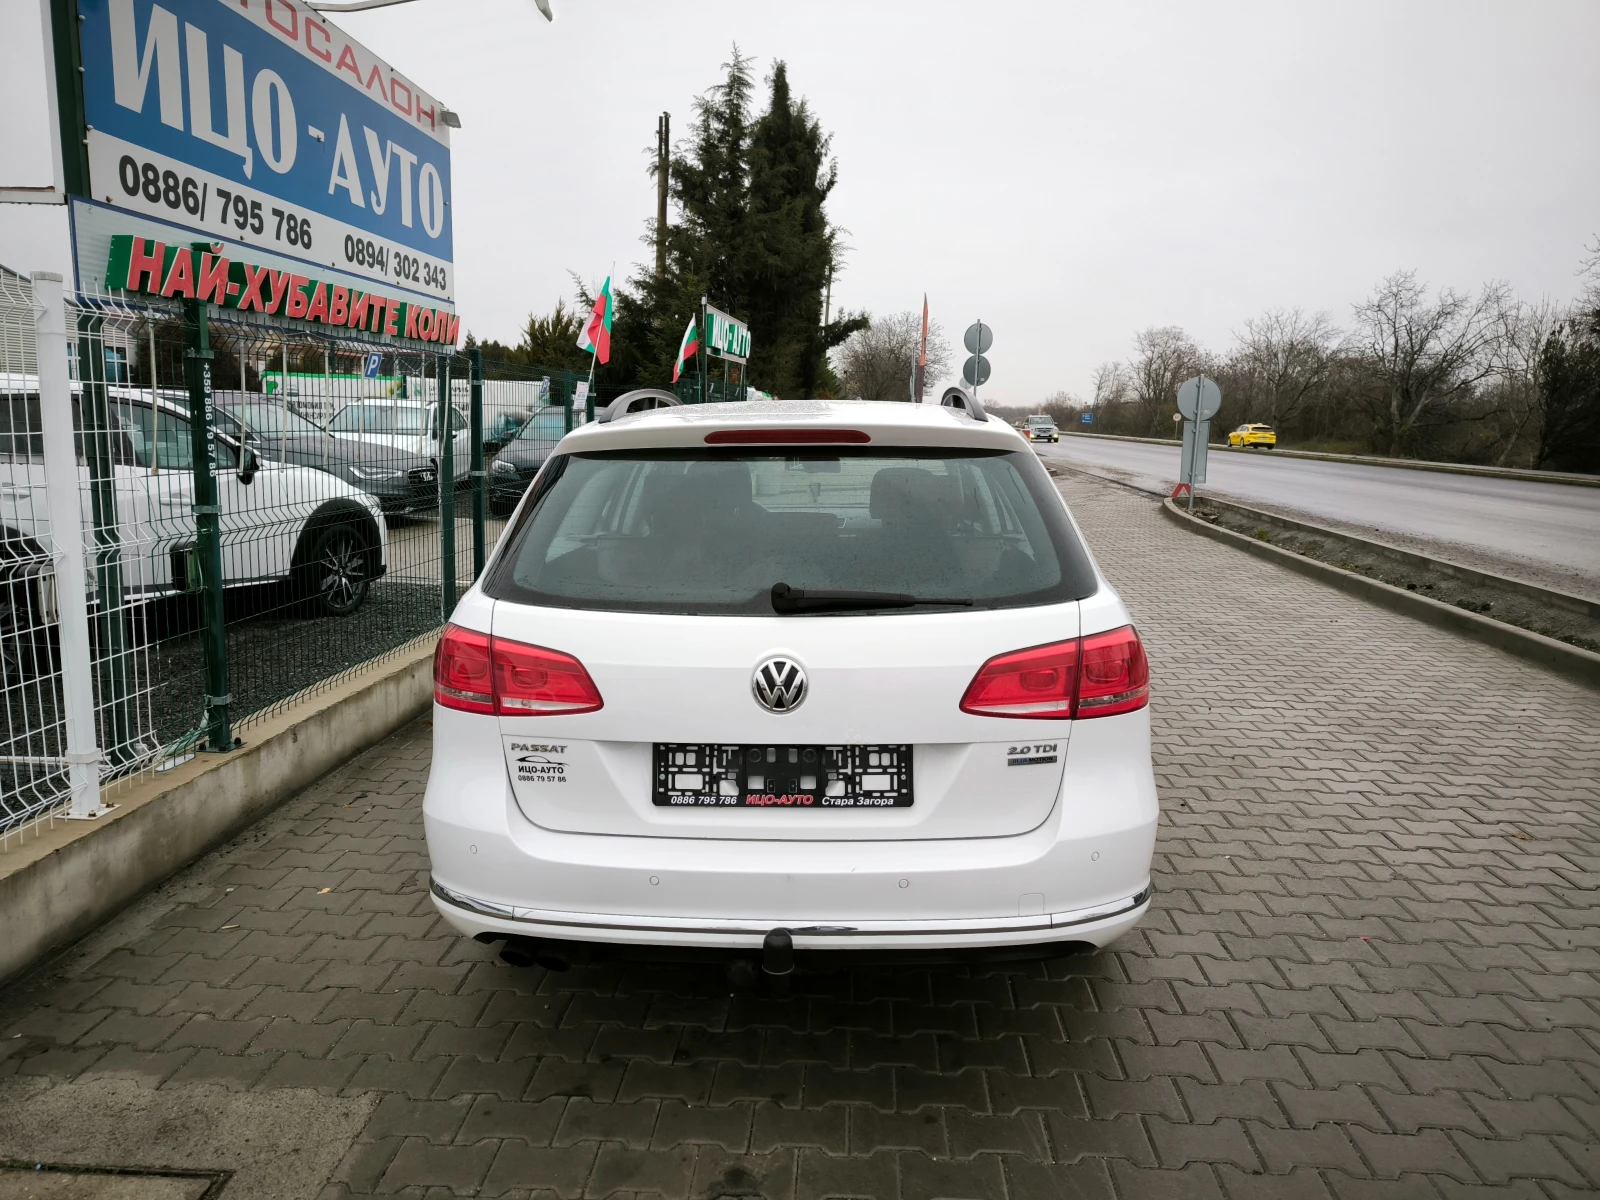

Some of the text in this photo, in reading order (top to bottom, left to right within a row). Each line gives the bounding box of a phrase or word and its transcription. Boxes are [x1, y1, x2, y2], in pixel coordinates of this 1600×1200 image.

[119, 155, 312, 250] 0886/ 795 786
[344, 234, 447, 291] 0894/ 302 343
[127, 236, 461, 346] НАЙ-ХУБАВИТЕ КОЛИ
[712, 313, 751, 359] ИЦО-АУТО
[203, 362, 217, 478] +359 886 79 57 86
[511, 742, 568, 753] PASSAT
[1007, 743, 1058, 755] 2.0 TDI
[517, 774, 535, 782] 0886
[518, 765, 564, 775] ИЦО-АУТО
[670, 794, 894, 806] 0886 795 786 ИЦО-АУТО Стара Загора
